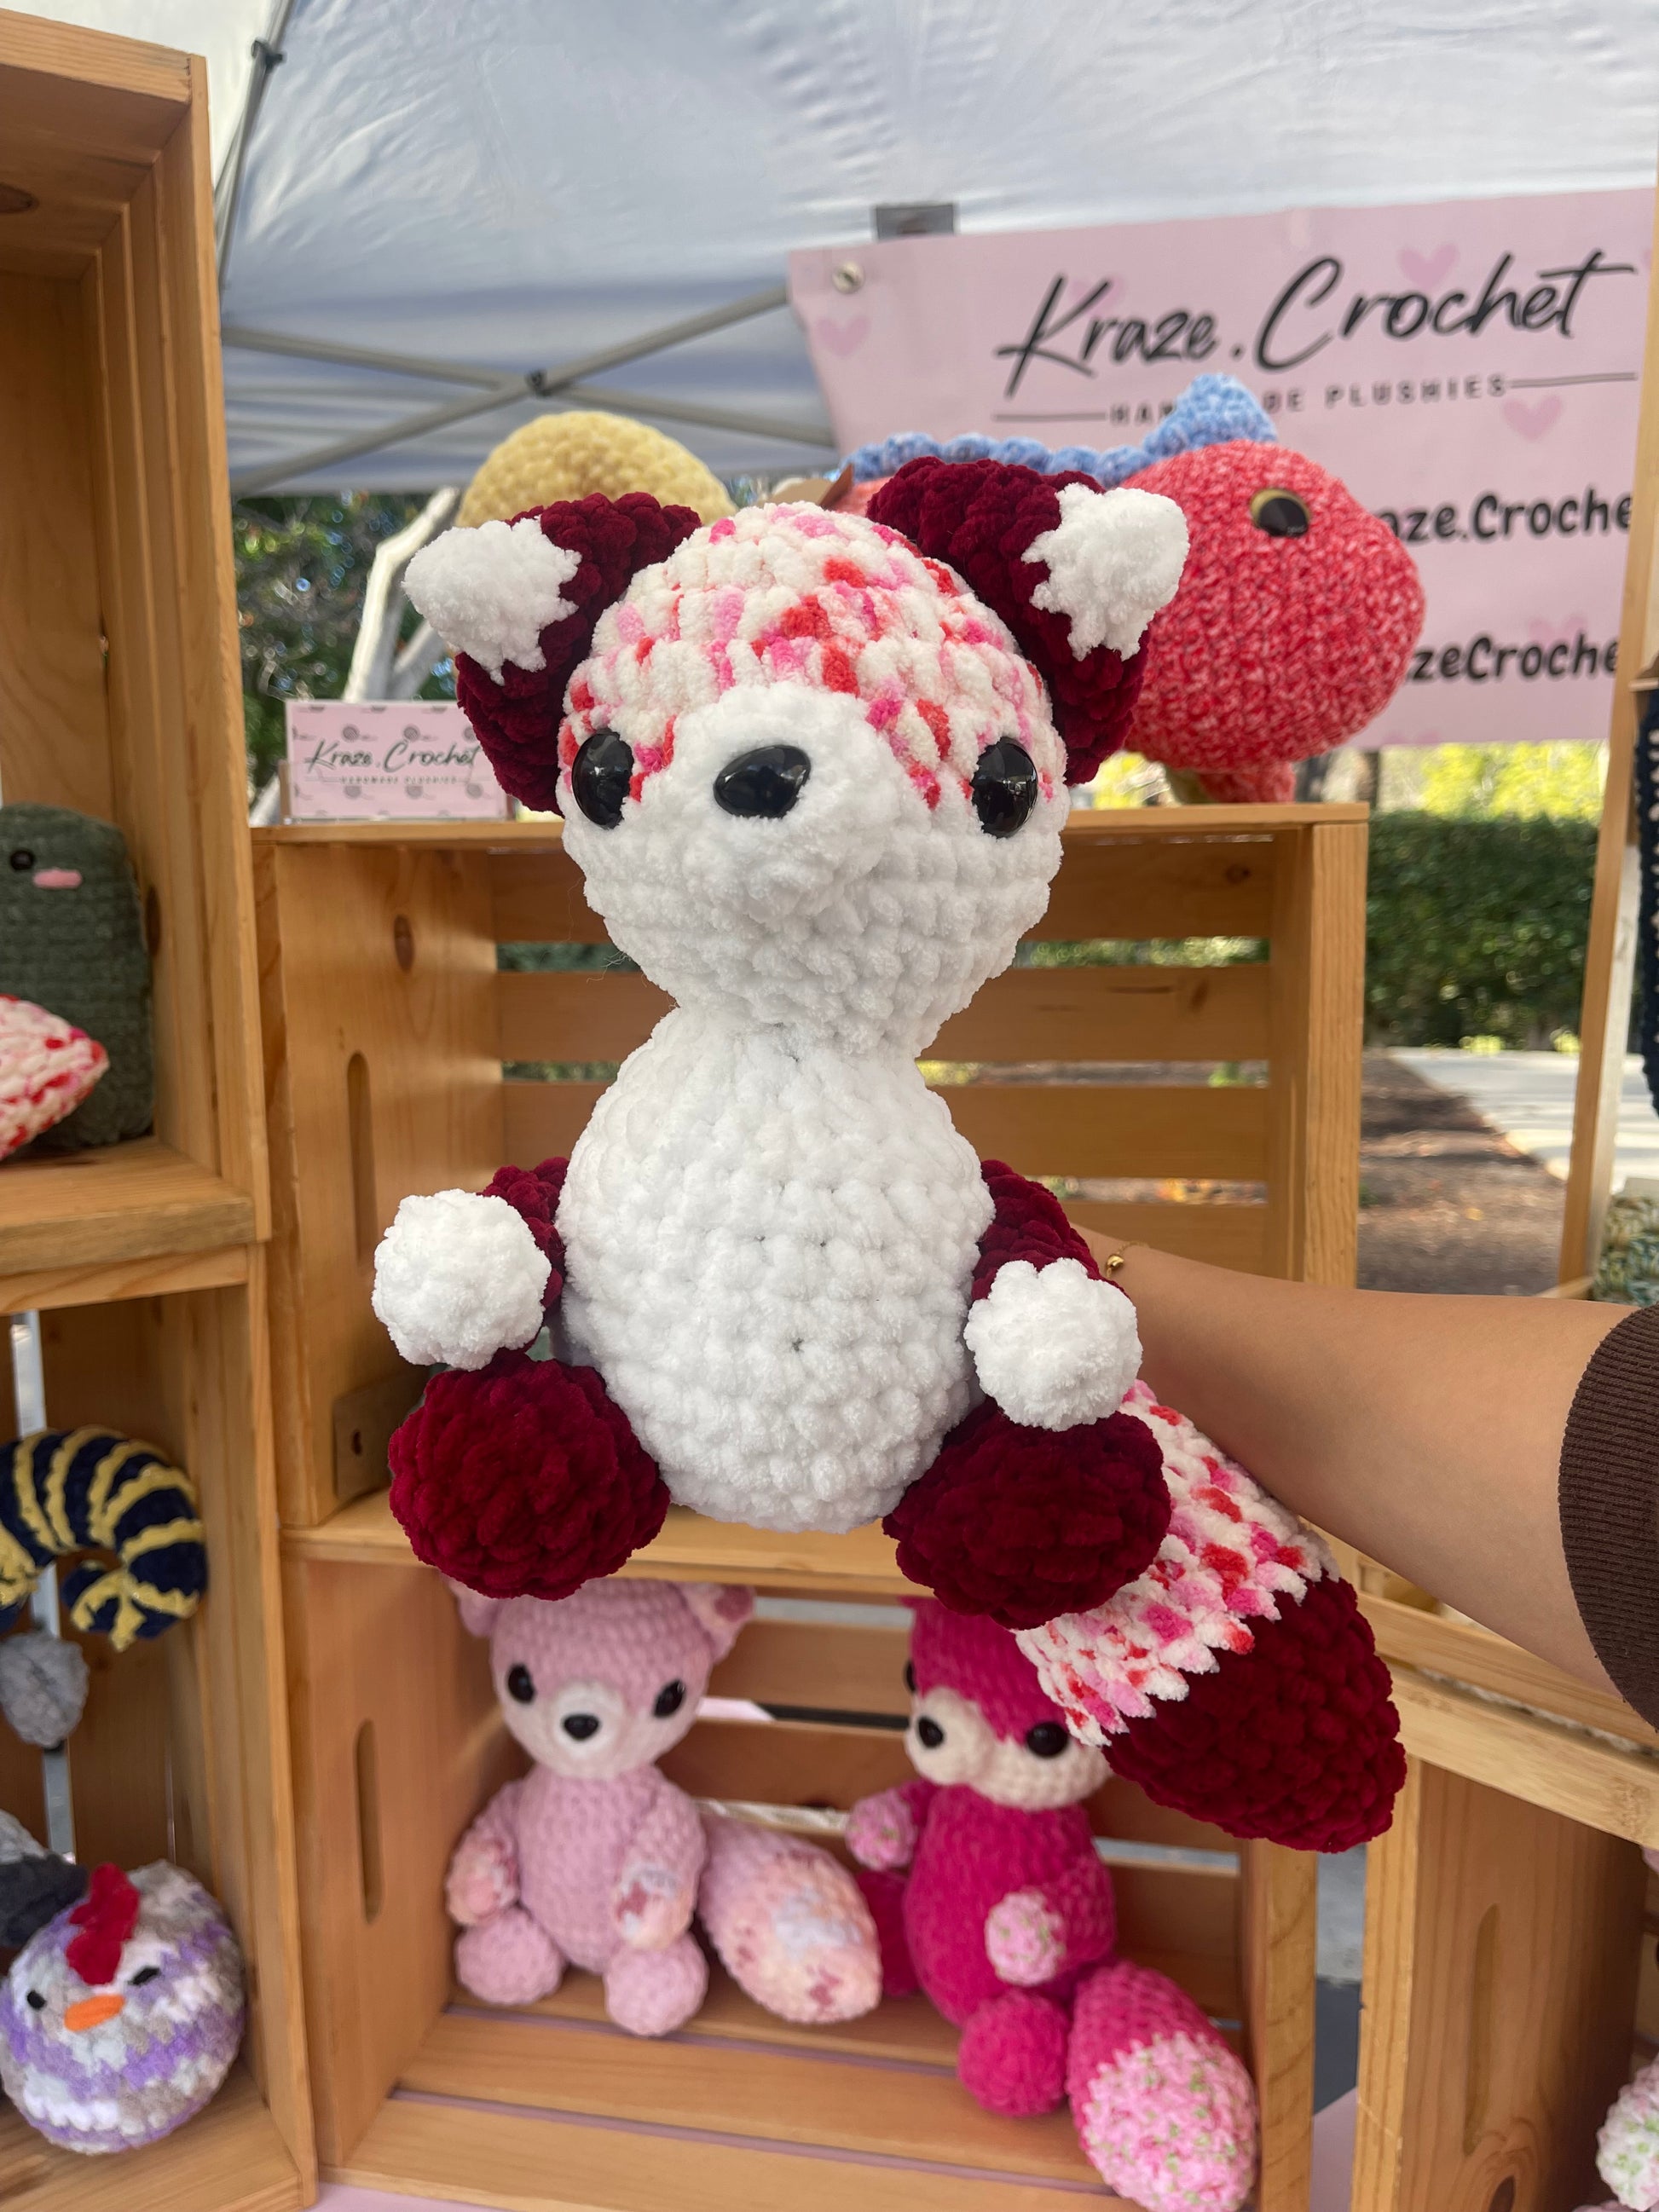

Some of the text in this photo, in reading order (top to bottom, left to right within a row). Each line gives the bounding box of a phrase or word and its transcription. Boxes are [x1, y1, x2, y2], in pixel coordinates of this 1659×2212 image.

[995, 251, 1637, 399] Kraze.Crochet
[1110, 373, 1506, 424] HANDE PLUSHIES
